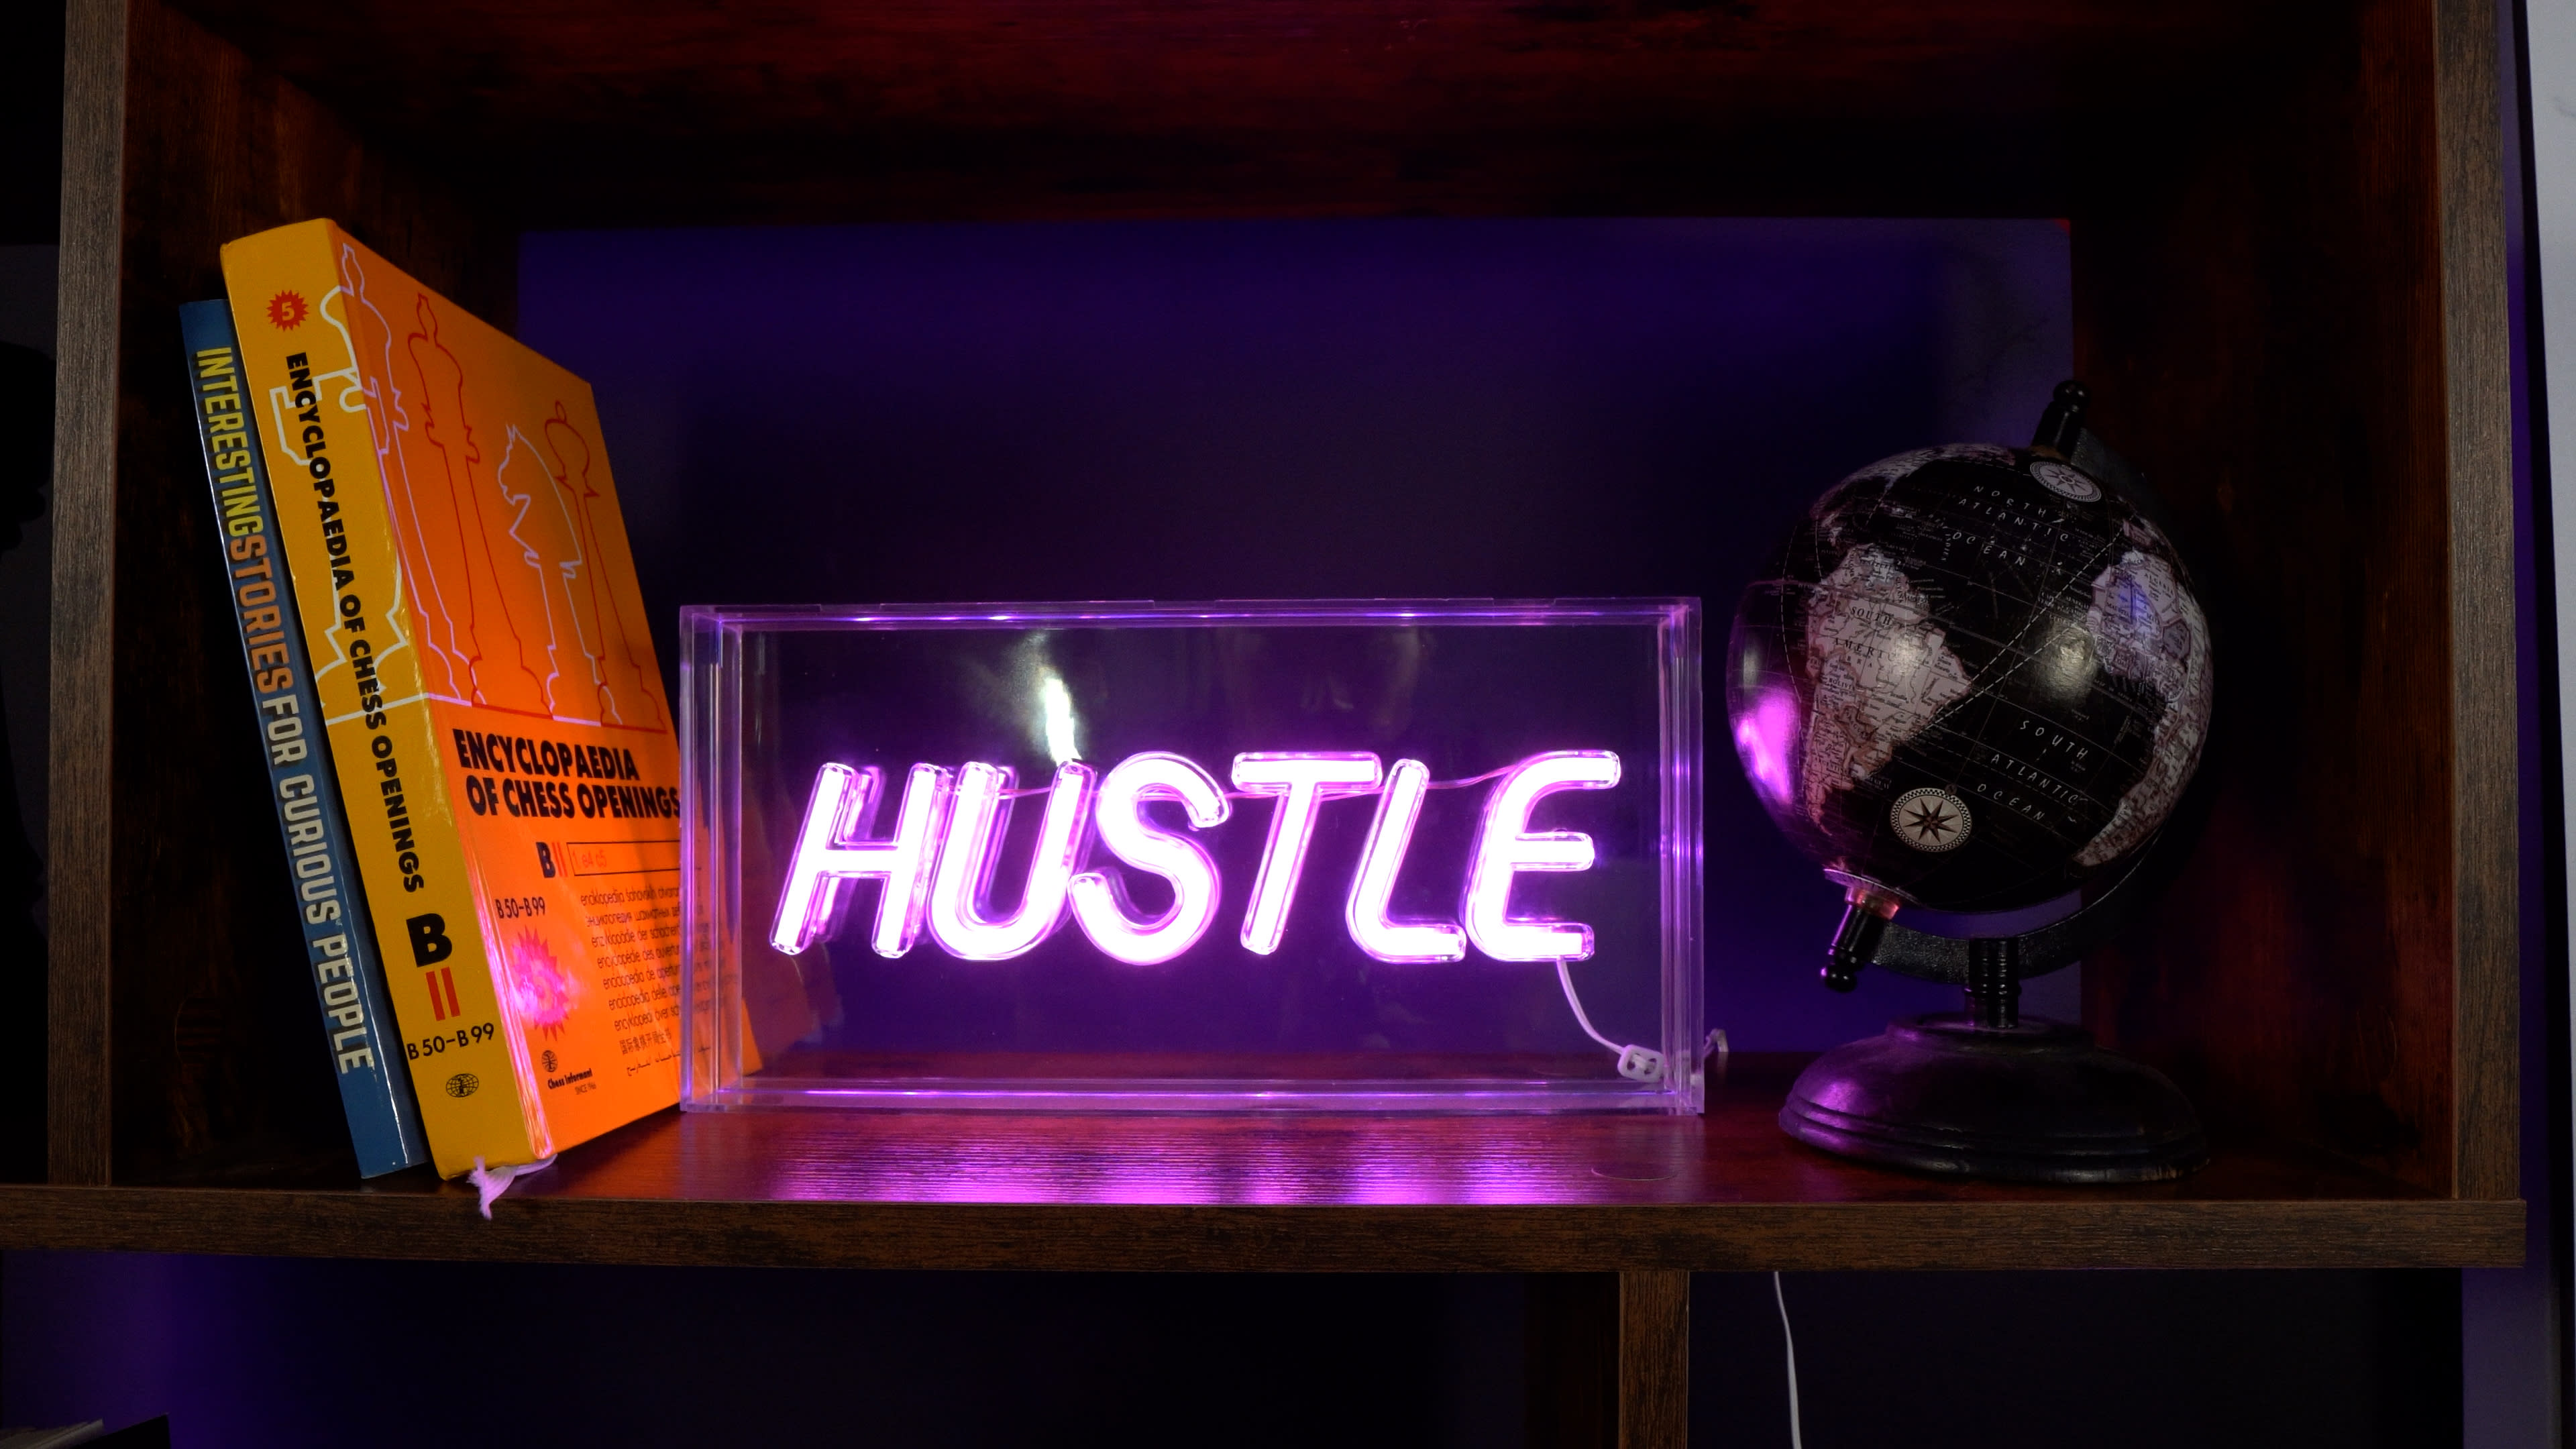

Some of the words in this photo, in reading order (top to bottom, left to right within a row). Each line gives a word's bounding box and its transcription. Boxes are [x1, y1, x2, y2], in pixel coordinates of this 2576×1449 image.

[280, 301, 295, 321] 5
[197, 347, 264, 538] INTERESTING
[286, 352, 355, 590] ENCYCLOPAEDIA
[1959, 498, 2068, 541] ATLANTIC
[1974, 486, 2047, 517] NORTH
[1952, 531, 2025, 566] OCEAN
[229, 535, 294, 694] STORIES
[339, 594, 366, 633] OF
[1851, 606, 1892, 625] SOUTH
[349, 639, 387, 730] CHESS
[262, 694, 307, 765] FOR
[2020, 720, 2088, 760] SOUTH
[452, 729, 641, 781] ENCYCLOPAEDIA
[1991, 753, 2078, 804] ATLANTIC
[372, 735, 424, 893] OPENINGS
[466, 775, 499, 816] OF
[502, 778, 576, 818] CHESS
[577, 782, 681, 819] OPENINGS
[1977, 784, 2045, 820] OCEAN
[279, 773, 341, 925] CURIOUS
[770, 750, 1621, 965] HUSTLE
[406, 912, 453, 968] B
[642, 945, 655, 961] des
[646, 965, 655, 981] de
[313, 933, 376, 1075] PEOPLE
[547, 1077, 565, 1090] Chess
[564, 1067, 593, 1085] Informant
